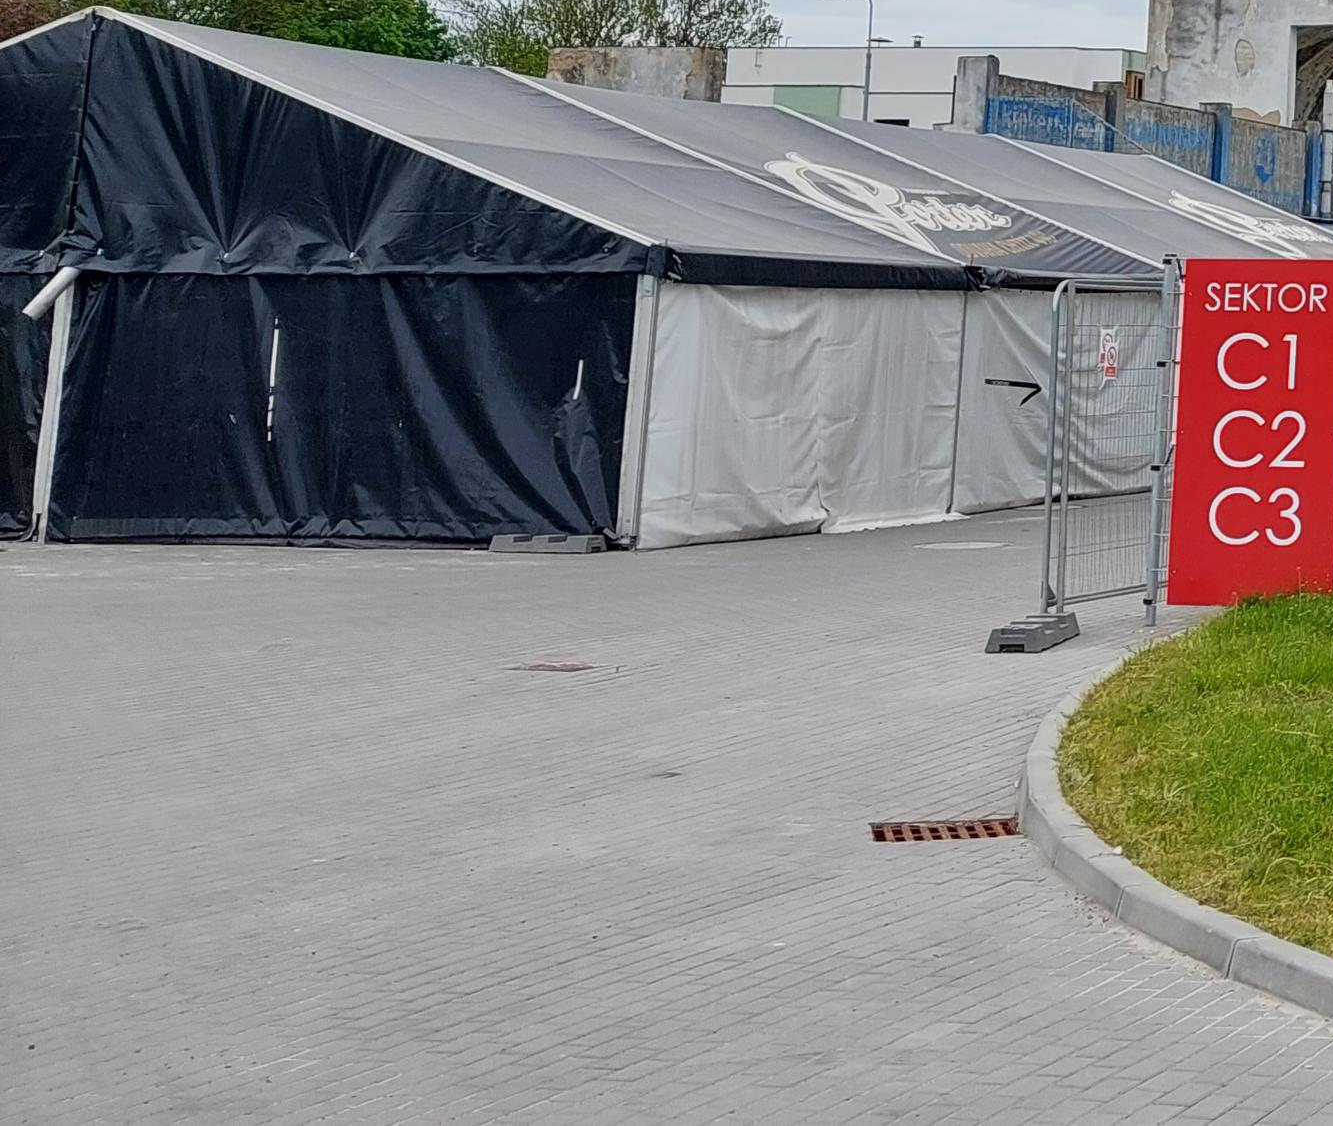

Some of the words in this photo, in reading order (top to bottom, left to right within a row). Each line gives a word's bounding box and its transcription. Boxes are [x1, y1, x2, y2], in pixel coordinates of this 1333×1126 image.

[1204, 282, 1328, 312] SEKTOR
[1216, 332, 1298, 390] C1
[1212, 410, 1306, 468] C2
[1208, 486, 1302, 546] C3
